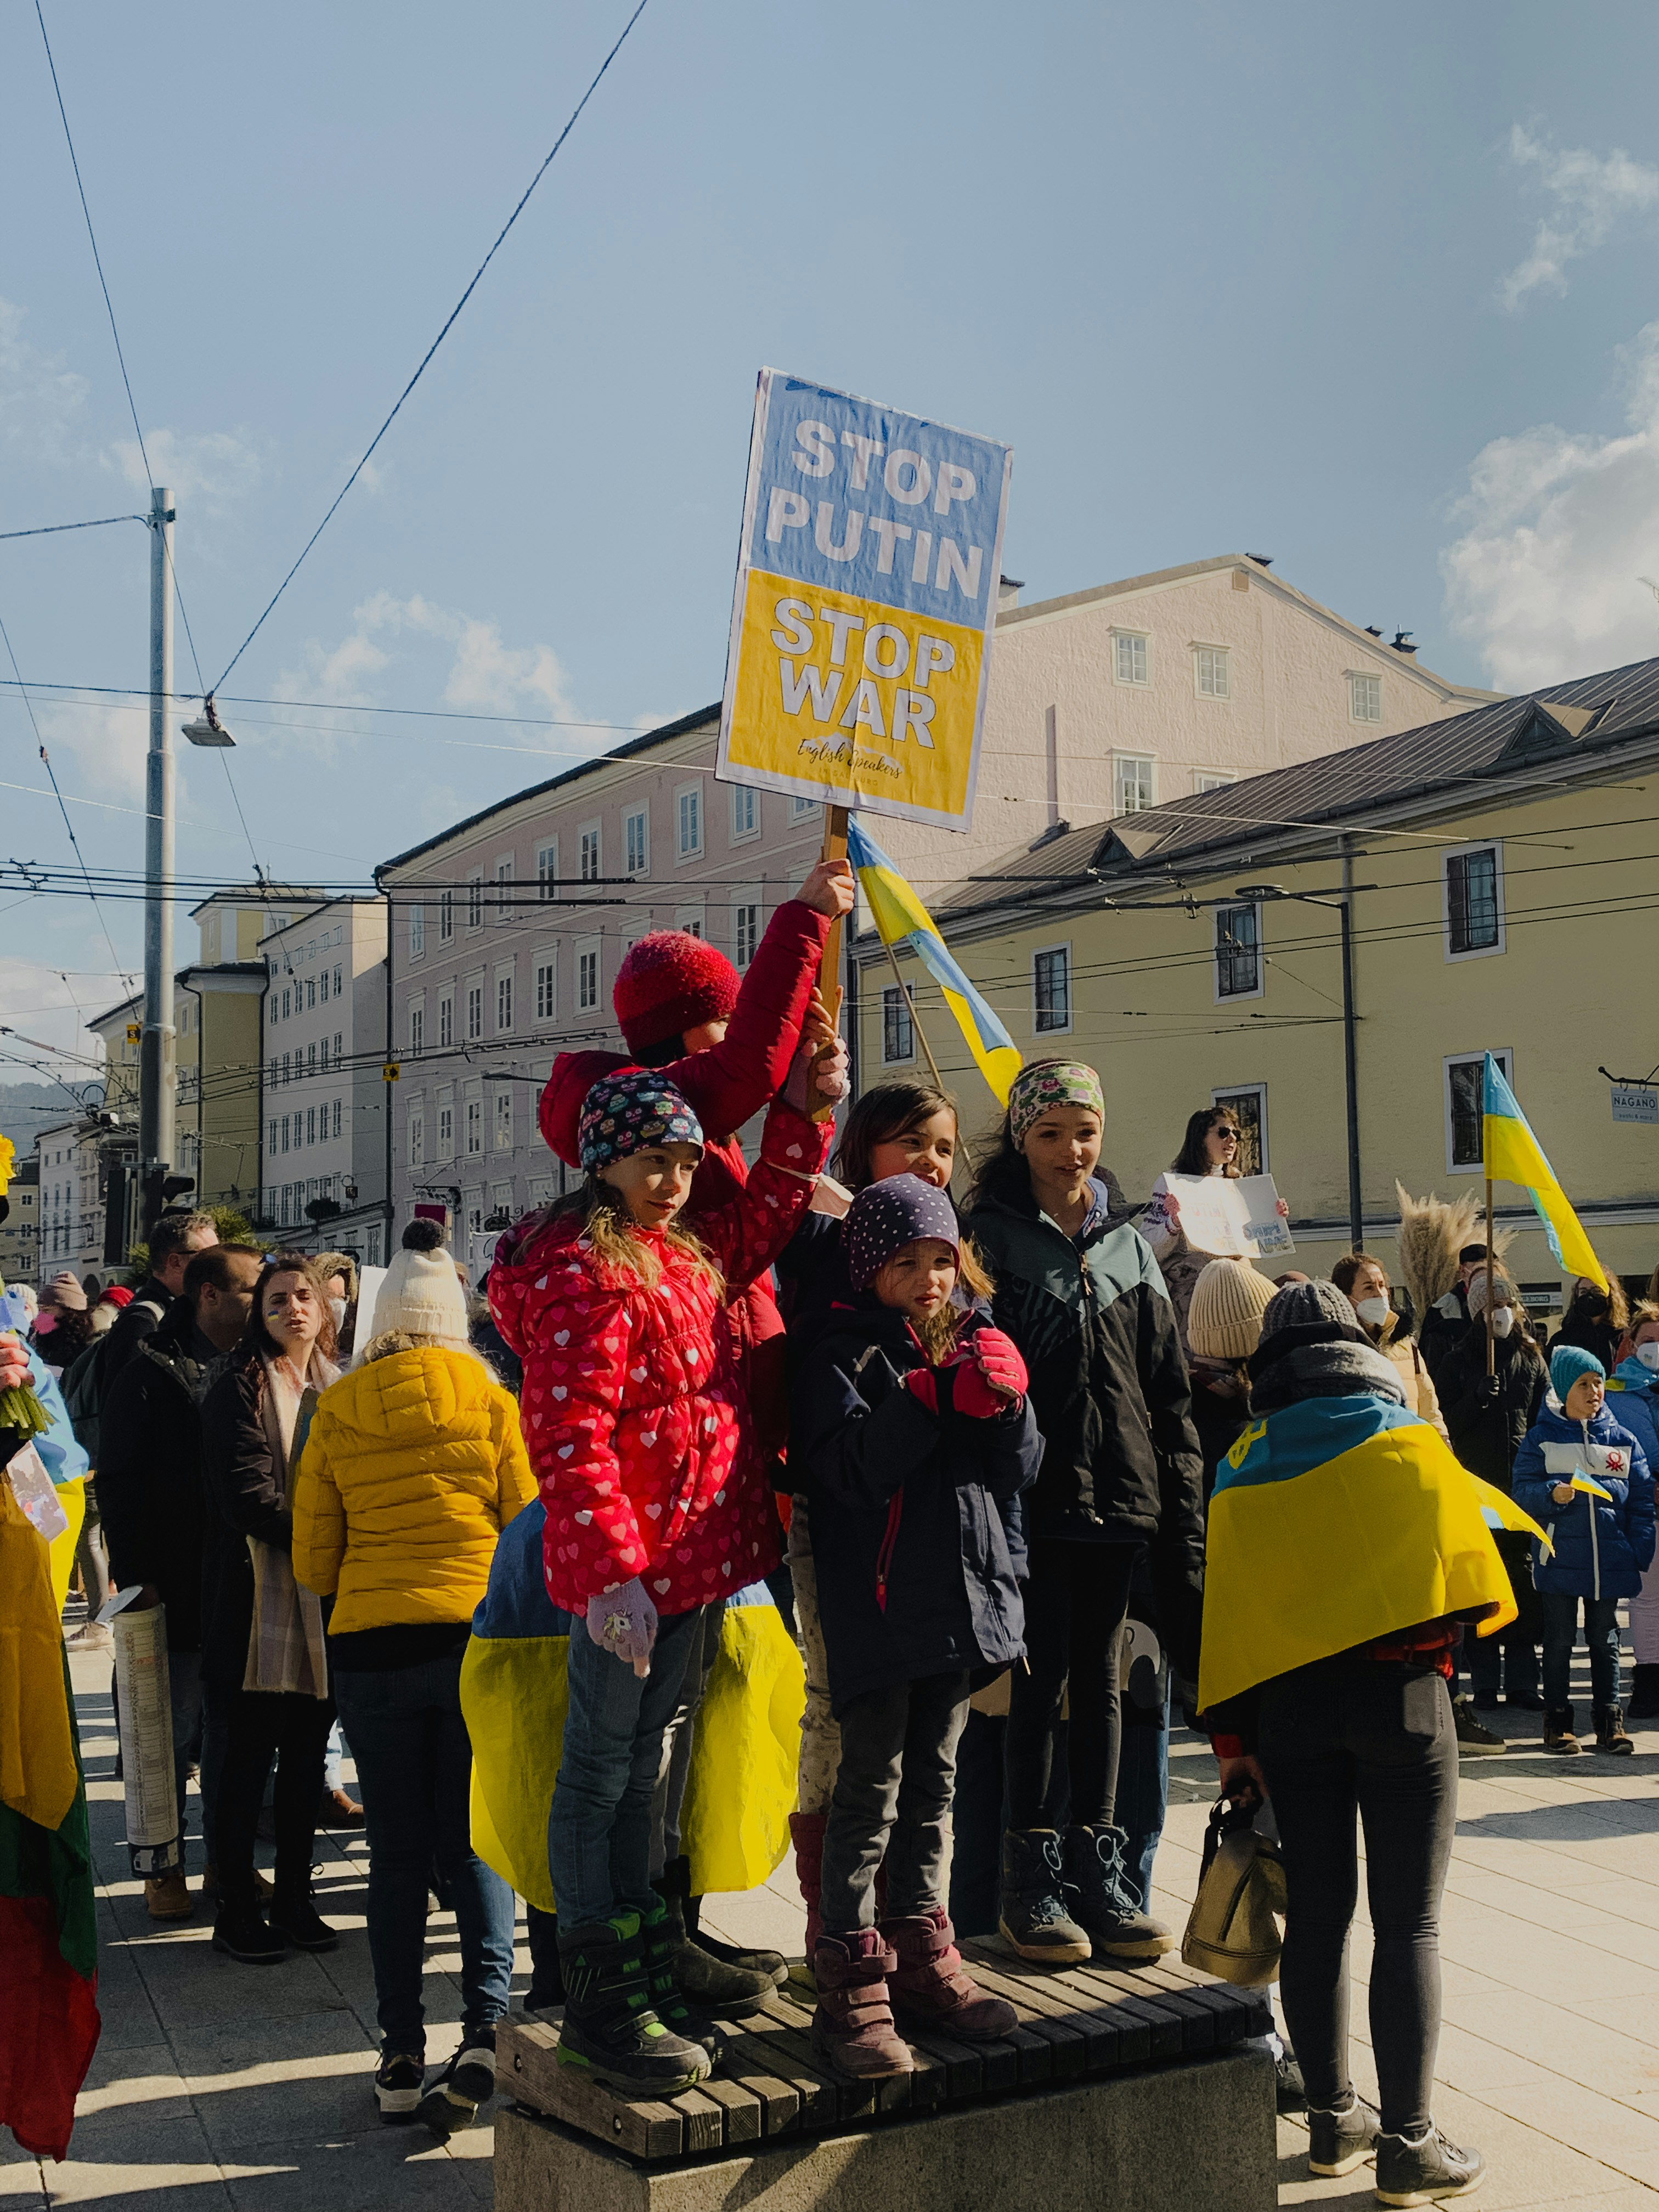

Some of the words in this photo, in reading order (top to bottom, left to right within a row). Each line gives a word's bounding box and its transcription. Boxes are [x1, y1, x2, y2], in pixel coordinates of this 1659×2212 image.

[791, 420, 977, 516] STOP
[765, 486, 983, 600] PUTIN
[770, 597, 955, 689] STOP
[778, 656, 937, 749] WAR
[798, 738, 845, 764] English
[847, 749, 902, 778] Speakers
[833, 770, 878, 786] SALURG
[1613, 1097, 1656, 1109] NAGANO
